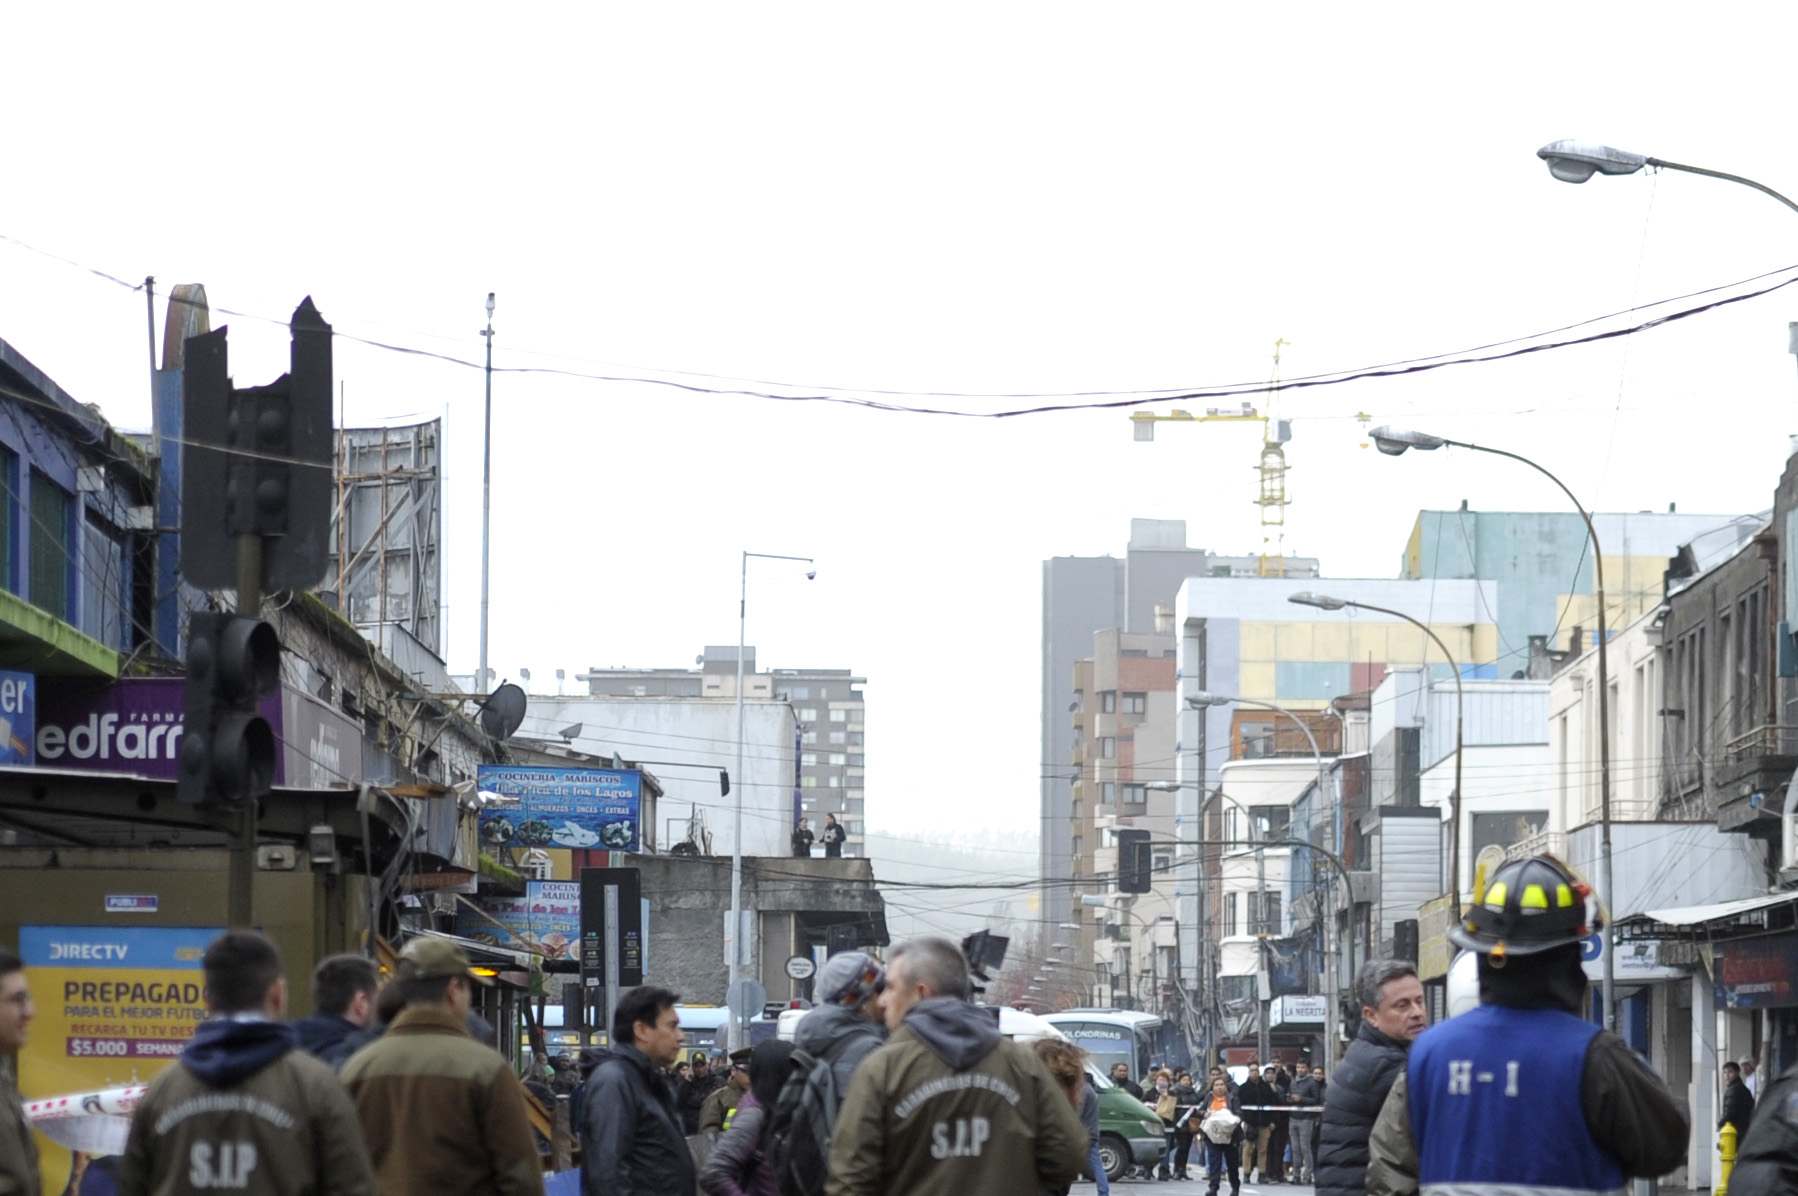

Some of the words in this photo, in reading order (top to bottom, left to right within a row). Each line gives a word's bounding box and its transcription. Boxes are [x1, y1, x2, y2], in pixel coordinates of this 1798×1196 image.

[565, 775, 622, 785] MARISCOS
[572, 786, 592, 797] los
[595, 788, 634, 799] Lagos
[49, 943, 129, 960] DIRECTV
[63, 1005, 100, 1018] PARA
[103, 1006, 118, 1018] EL
[120, 1006, 163, 1019] MEJOR
[71, 1024, 127, 1036] RECARGA
[132, 1025, 148, 1036] TU
[152, 1026, 167, 1037] TV
[71, 1039, 128, 1057] $5.000
